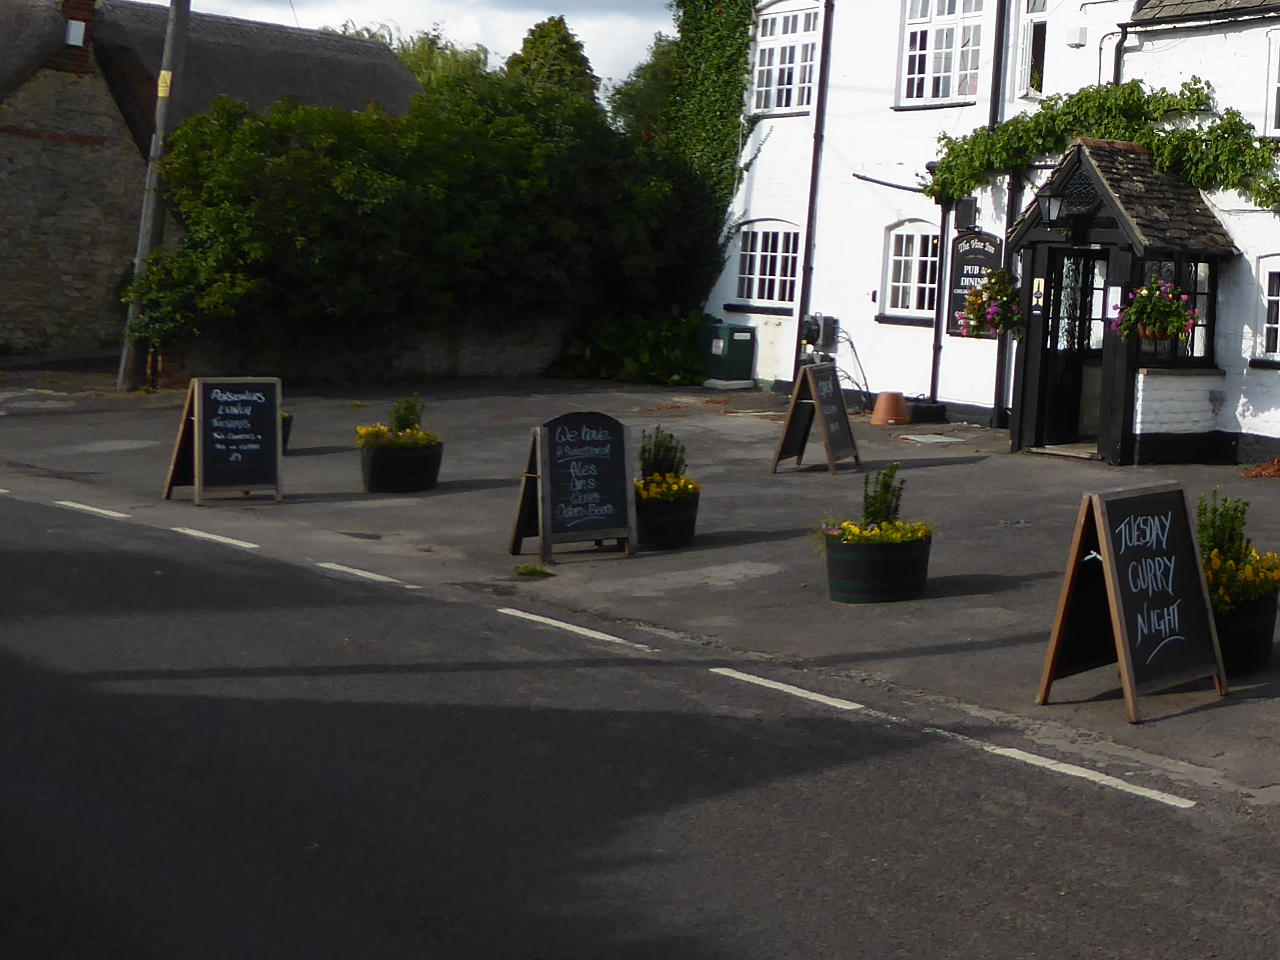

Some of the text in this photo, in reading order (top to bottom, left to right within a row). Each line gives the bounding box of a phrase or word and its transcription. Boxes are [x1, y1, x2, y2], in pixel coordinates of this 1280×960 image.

[958, 240, 970, 253] The
[971, 238, 984, 249] Vine
[963, 265, 979, 274] PUB
[556, 424, 613, 442] We have
[569, 460, 598, 477] Ales
[1115, 511, 1172, 555] TUESDAY
[1128, 555, 1176, 597] CURRY
[1136, 598, 1182, 648] NIGHT
